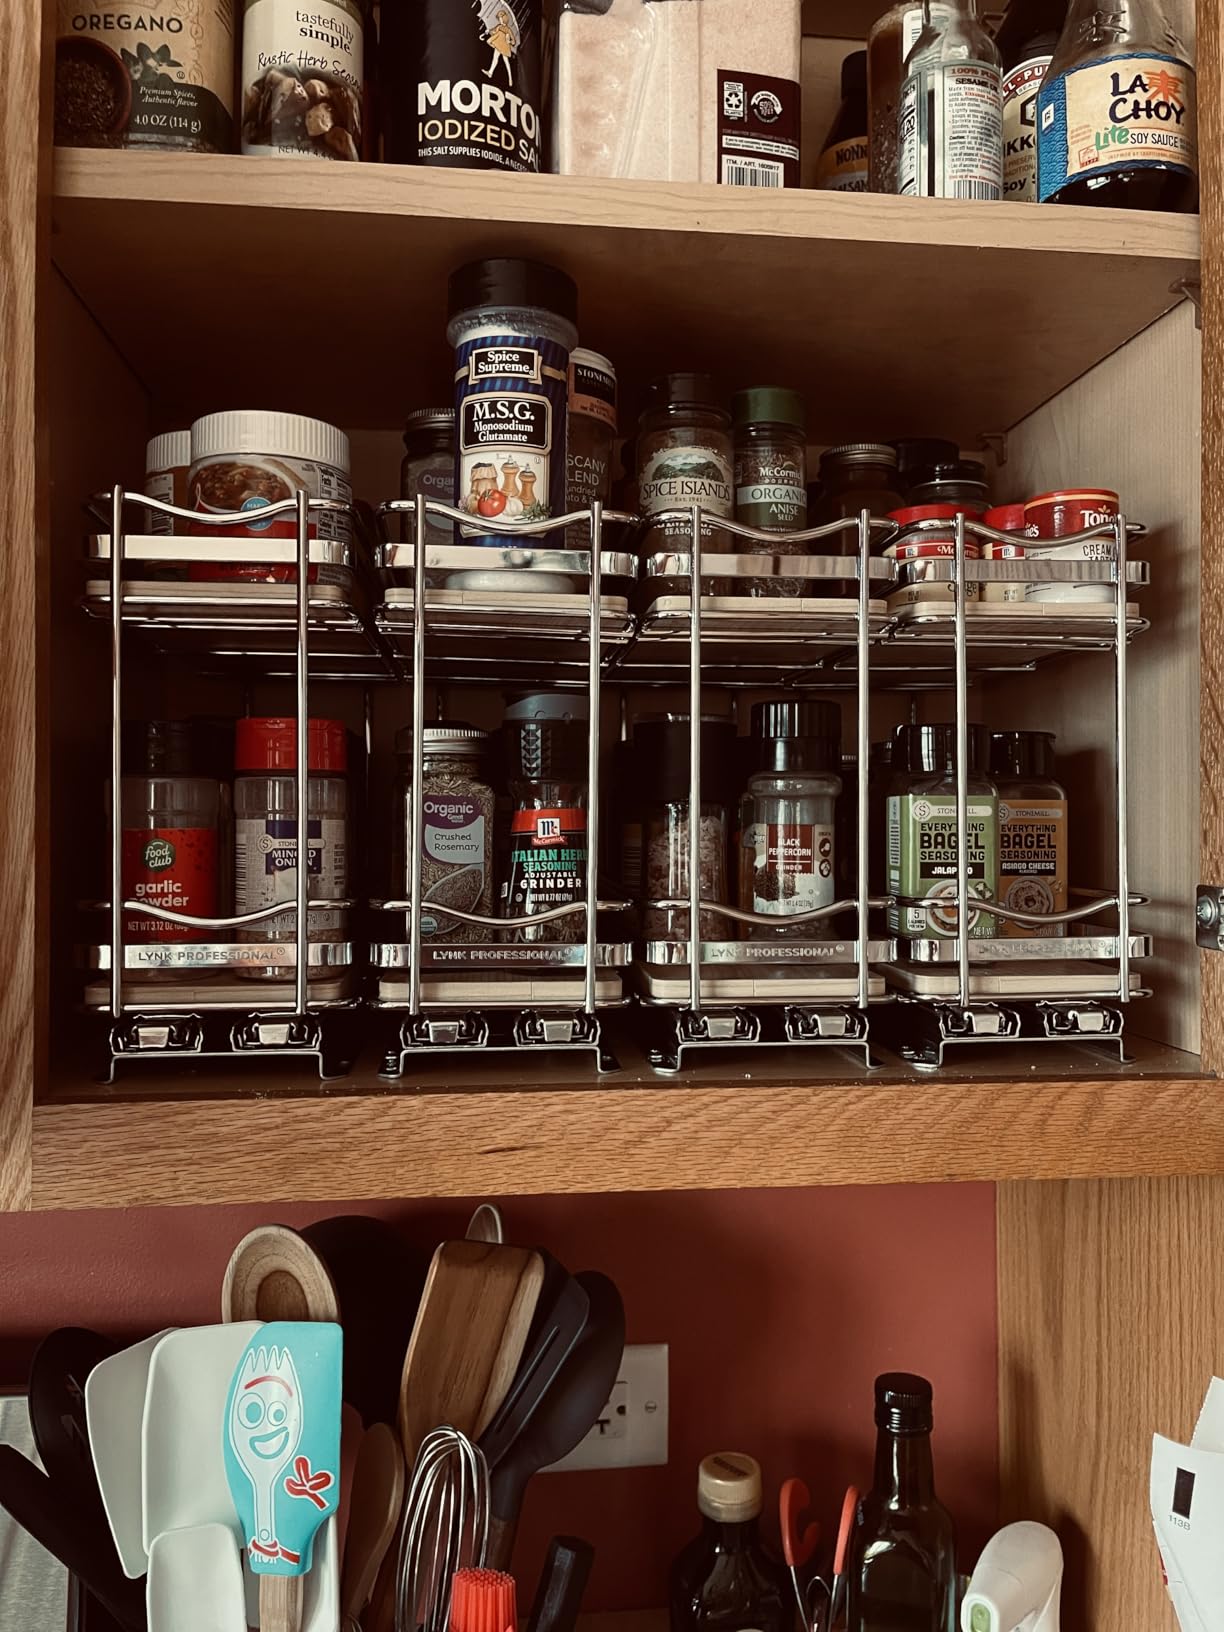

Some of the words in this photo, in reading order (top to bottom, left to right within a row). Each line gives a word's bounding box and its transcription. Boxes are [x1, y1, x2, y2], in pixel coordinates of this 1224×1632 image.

[71, 14, 183, 34] OREGANO
[296, 10, 354, 44] tastefully
[299, 25, 353, 57] simple
[257, 51, 294, 71] Rustic
[296, 50, 328, 70] Herb
[955, 78, 989, 88] SESAME
[1110, 72, 1149, 97] LA
[1109, 97, 1185, 125] CHOY
[150, 114, 167, 126] OZ
[169, 116, 188, 128] (114
[418, 119, 516, 151] IODIZED
[1095, 125, 1130, 151] Lite
[1130, 133, 1149, 145] SOY
[1151, 133, 1179, 148] SAUCE
[418, 147, 432, 157] THIS
[433, 146, 448, 155] SALT
[449, 146, 481, 158] SUPPLIES
[481, 150, 505, 165] IODIDE,
[487, 350, 520, 363] Spice
[478, 361, 530, 374] Supreme
[472, 400, 535, 421] M.S.G.
[473, 419, 534, 433] Monosodium
[478, 431, 528, 442] Glutamate
[567, 454, 606, 475] SCANY
[758, 466, 800, 480] McCormic
[423, 474, 454, 489] Orga
[643, 481, 678, 500] SPICE
[680, 480, 731, 502] ISLANDS
[769, 503, 799, 516] ANISE
[777, 513, 794, 522] SEED
[664, 527, 712, 536] SEASONG
[1082, 544, 1111, 557] CREAM
[423, 801, 474, 817] Organic
[920, 823, 985, 832] EVERYING
[1001, 824, 1057, 833] EVERYTHING
[434, 833, 472, 841] Crushed
[1000, 833, 1057, 849] BAGEL
[145, 844, 170, 860] food
[271, 849, 317, 858] MIND
[434, 842, 480, 853] Rosemary
[768, 847, 812, 856] PEERCORN
[511, 849, 558, 862] ITALIAN
[920, 851, 985, 861] SEASONG
[1000, 850, 1057, 860] SEASONING
[149, 857, 172, 867] club
[275, 858, 313, 867] ONIN
[523, 862, 577, 872] SEASONING
[1002, 862, 1027, 870] ASIAGO
[1028, 862, 1055, 870] CHEESE
[524, 871, 577, 879] ADJUSTABLE
[931, 866, 974, 875] JALAPO
[135, 880, 182, 896] garlic
[520, 879, 582, 889] GRINDER
[128, 894, 189, 907] wder
[914, 909, 920, 919] 5
[128, 922, 139, 931] NET
[140, 922, 150, 931] WT
[138, 952, 172, 961] LYNK
[177, 951, 277, 961] PROFESSIONAL
[432, 951, 467, 960] LYNK
[470, 951, 565, 960] PROFESSIONAL
[711, 949, 737, 957] LYN
